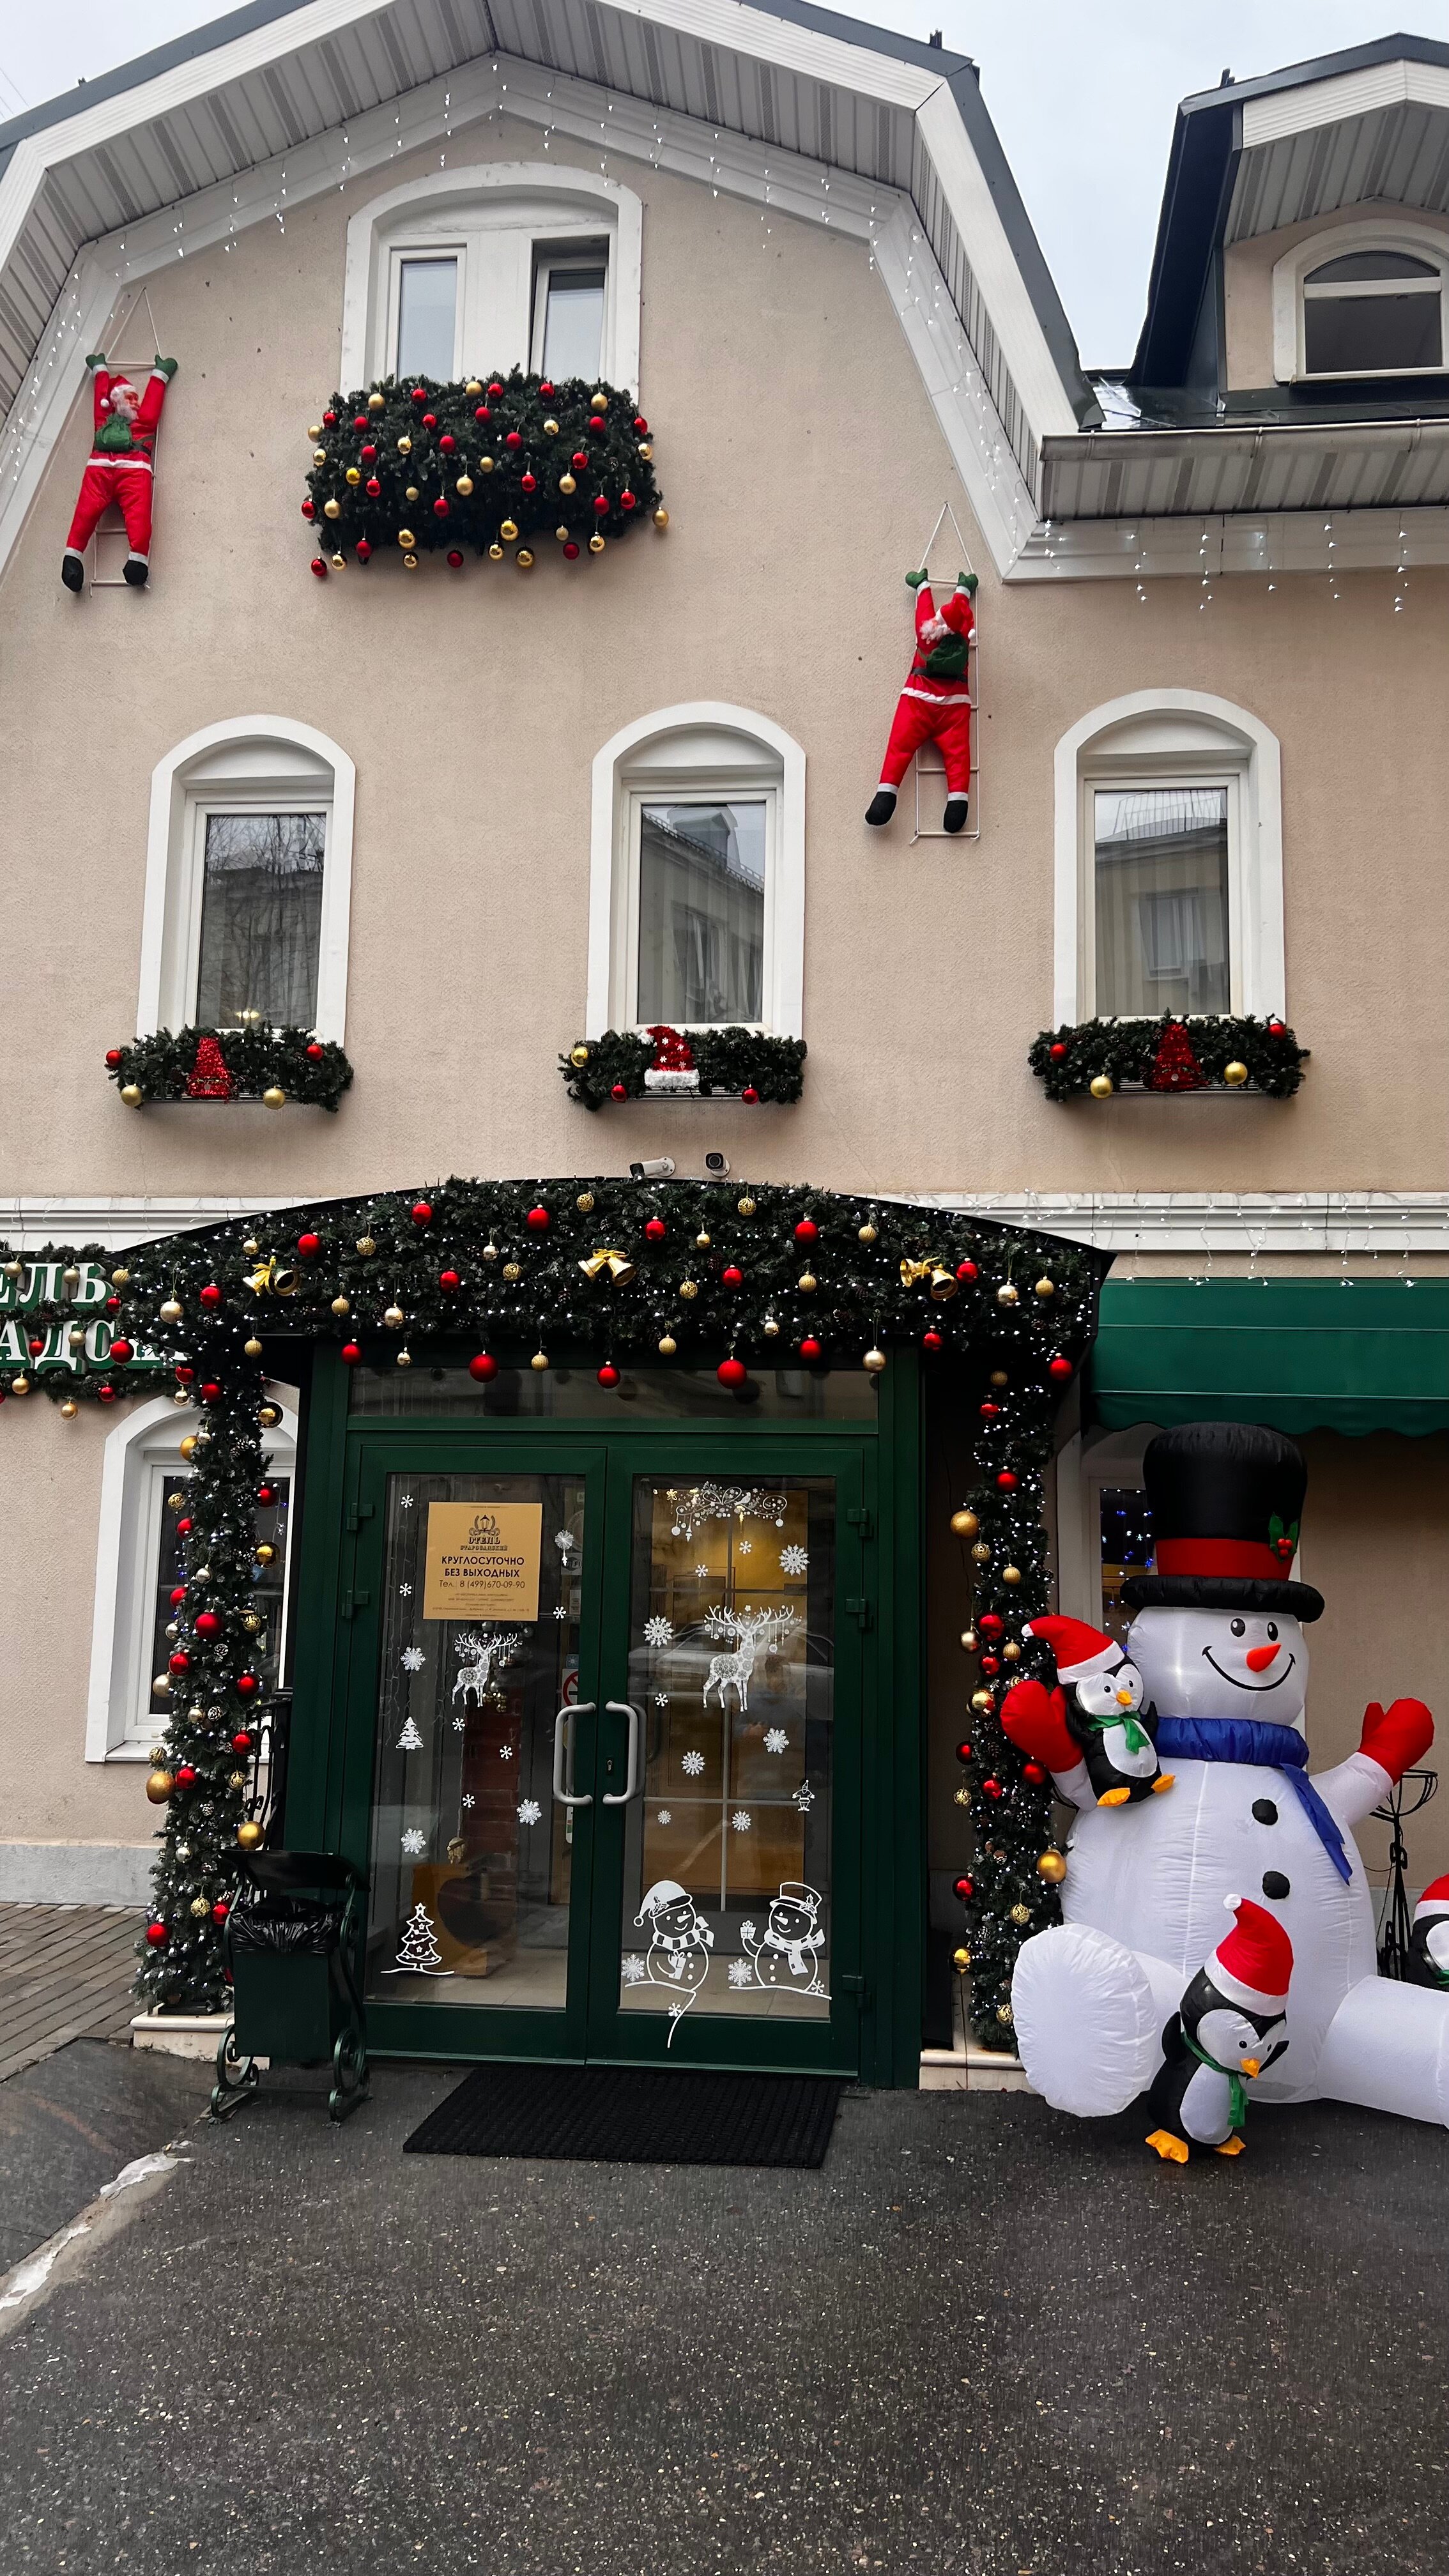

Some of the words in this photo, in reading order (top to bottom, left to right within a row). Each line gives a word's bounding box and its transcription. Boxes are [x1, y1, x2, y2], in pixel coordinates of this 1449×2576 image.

[441, 1556, 525, 1565] КРУГЛОСУТОЧНО
[445, 1568, 460, 1576] БЕЗ
[463, 1568, 520, 1578] ВЫХОДНЫХ
